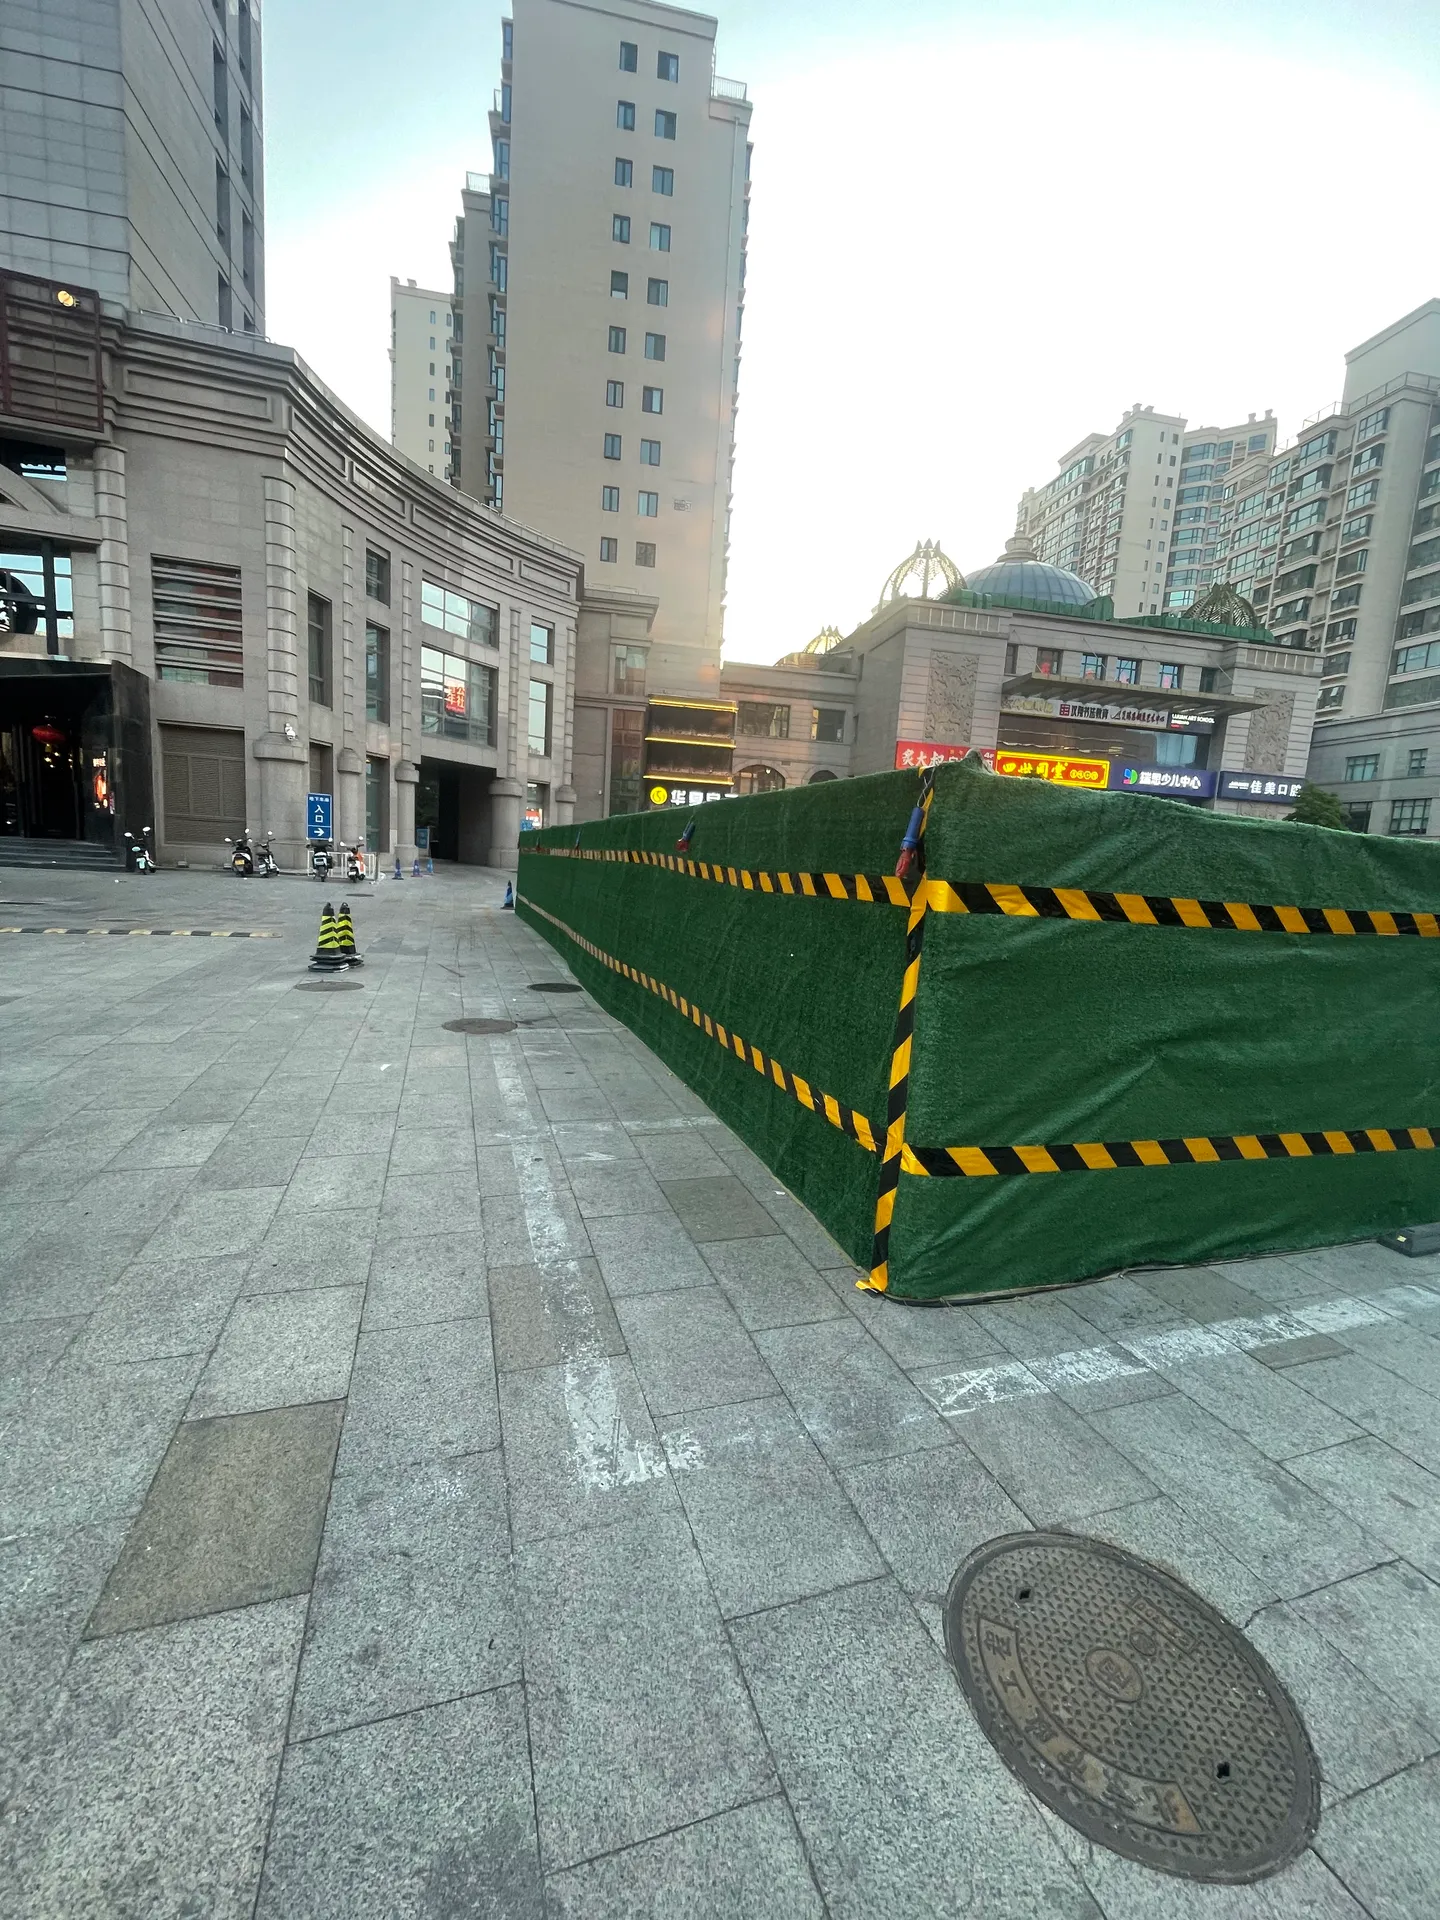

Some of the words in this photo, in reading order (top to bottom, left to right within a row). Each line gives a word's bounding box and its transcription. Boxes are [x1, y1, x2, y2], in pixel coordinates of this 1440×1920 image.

[1250, 780, 1302, 798] 佳美口腔
[314, 804, 325, 823] 入口
